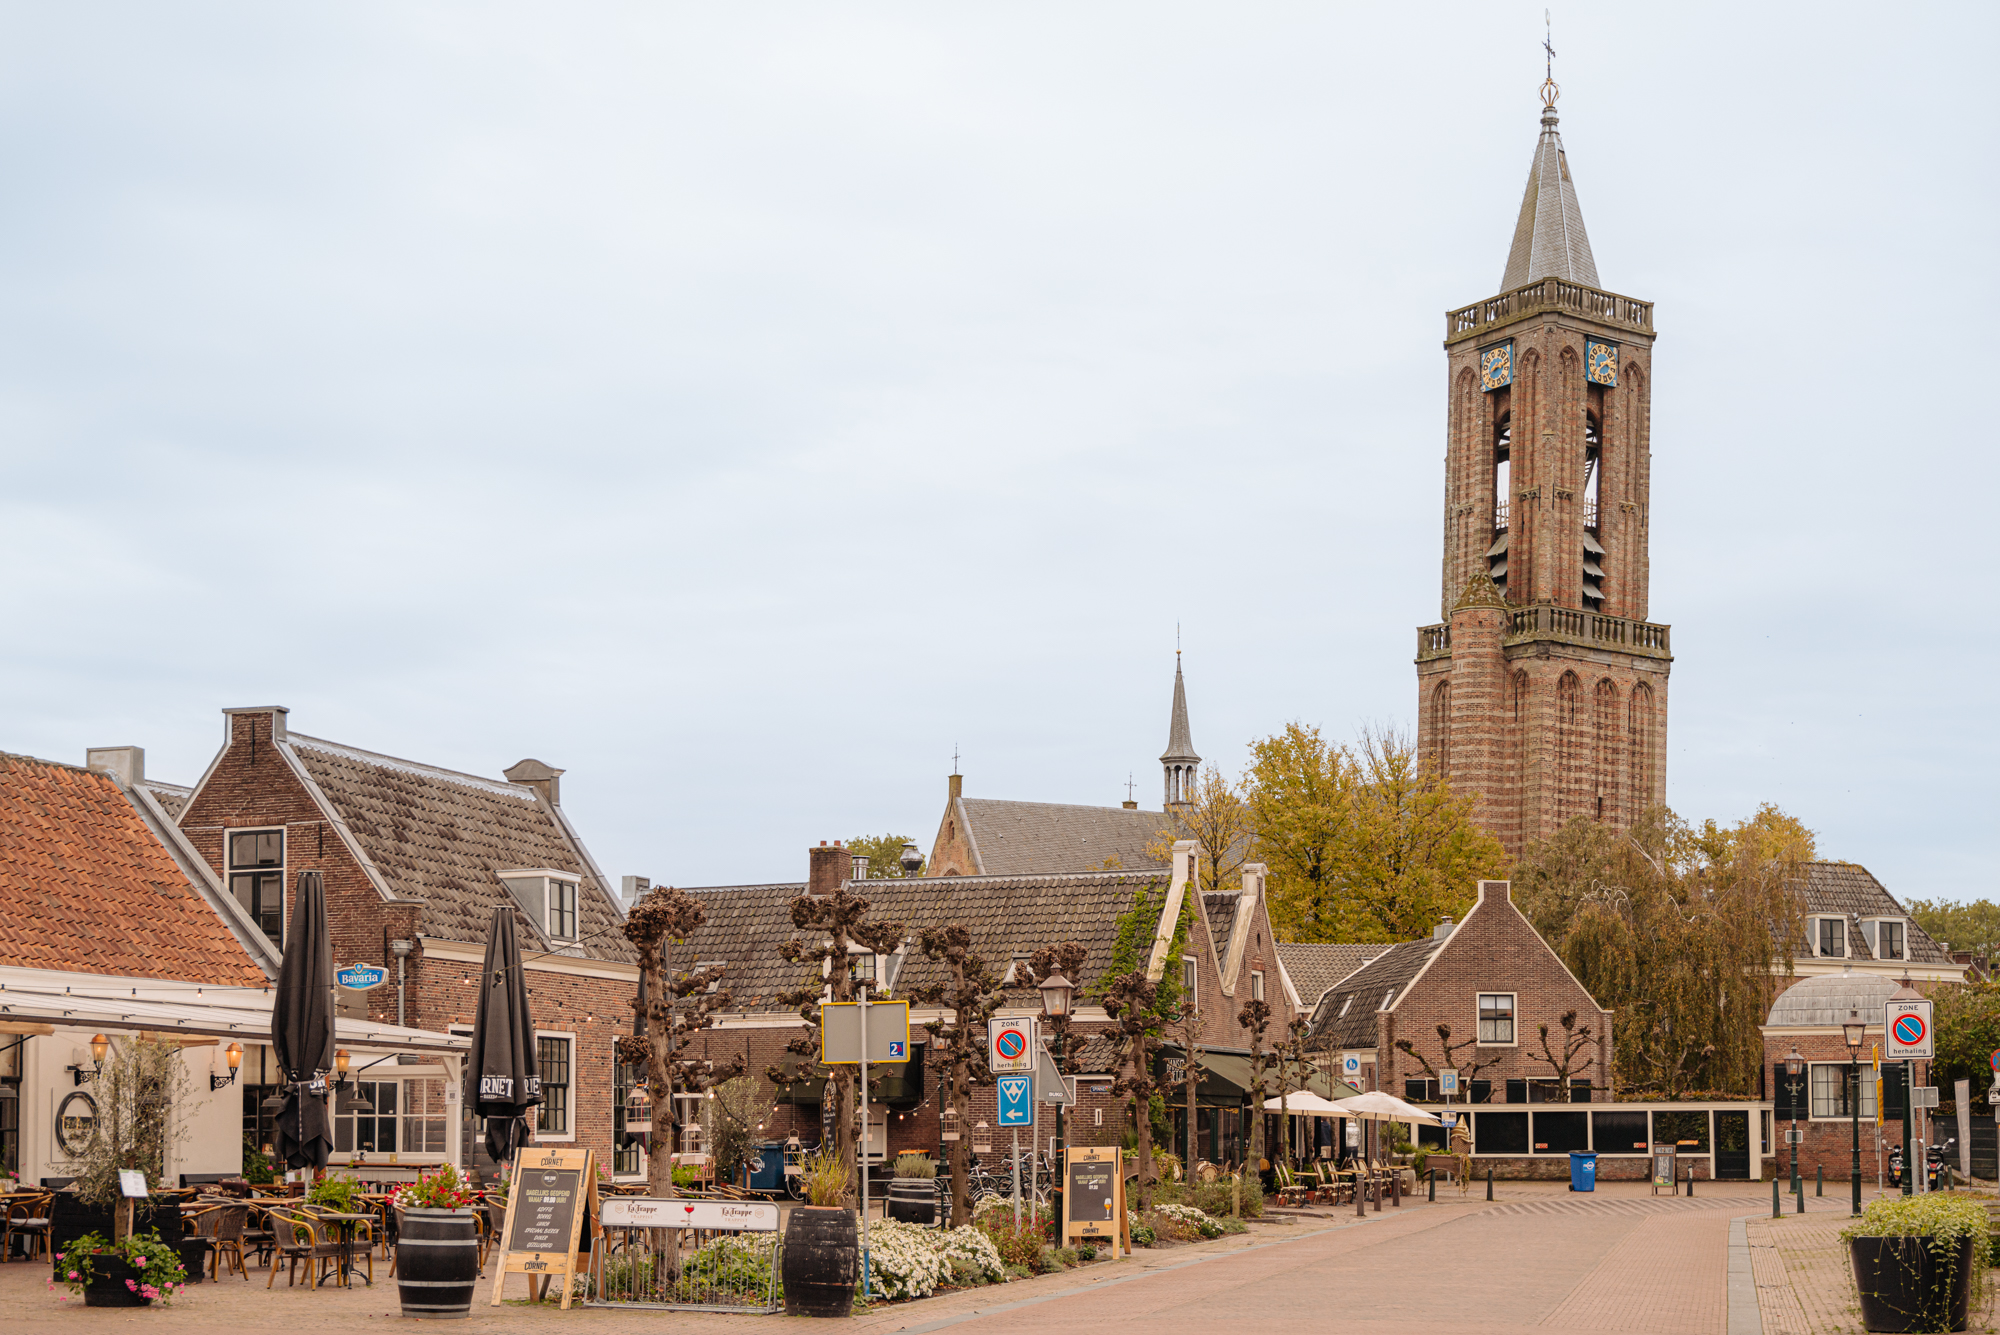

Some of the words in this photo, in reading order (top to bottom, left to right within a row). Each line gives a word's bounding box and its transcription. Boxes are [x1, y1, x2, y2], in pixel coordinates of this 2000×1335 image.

[341, 972, 379, 984] Bavaria
[1445, 1076, 1453, 1087] P
[540, 1158, 563, 1167] CORNET
[626, 1203, 635, 1214] La
[635, 1204, 658, 1214] Trappe
[720, 1207, 729, 1218] La
[729, 1207, 752, 1218] Trappe
[524, 1261, 548, 1271] CORNET
